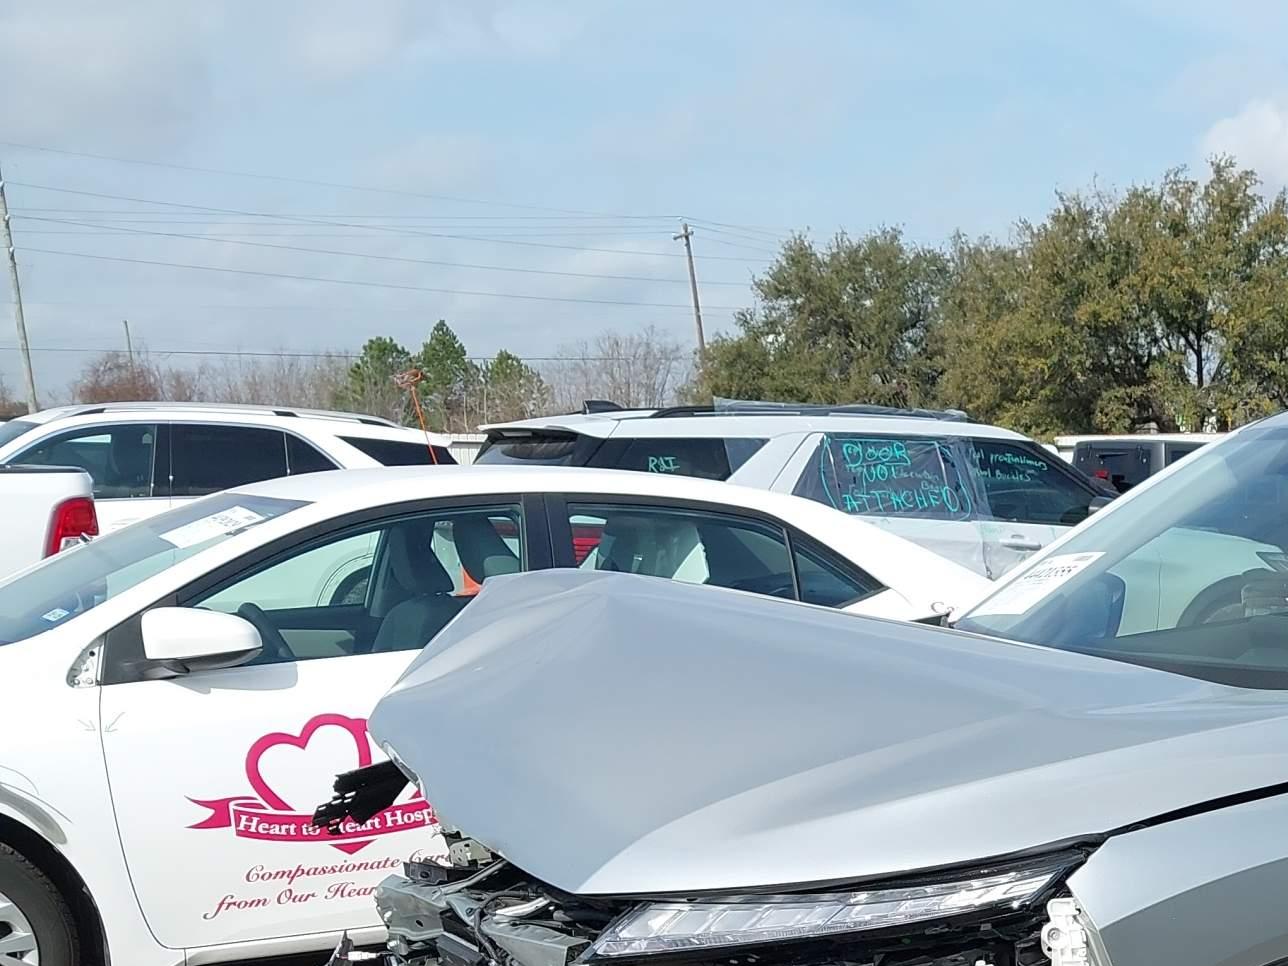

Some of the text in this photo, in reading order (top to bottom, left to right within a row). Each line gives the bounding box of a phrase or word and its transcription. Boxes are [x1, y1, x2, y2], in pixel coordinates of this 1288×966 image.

[237, 814, 297, 836] Heart
[338, 816, 381, 834] eart
[245, 857, 401, 885] Compassionate
[203, 894, 271, 920] from
[276, 888, 318, 905] Our
